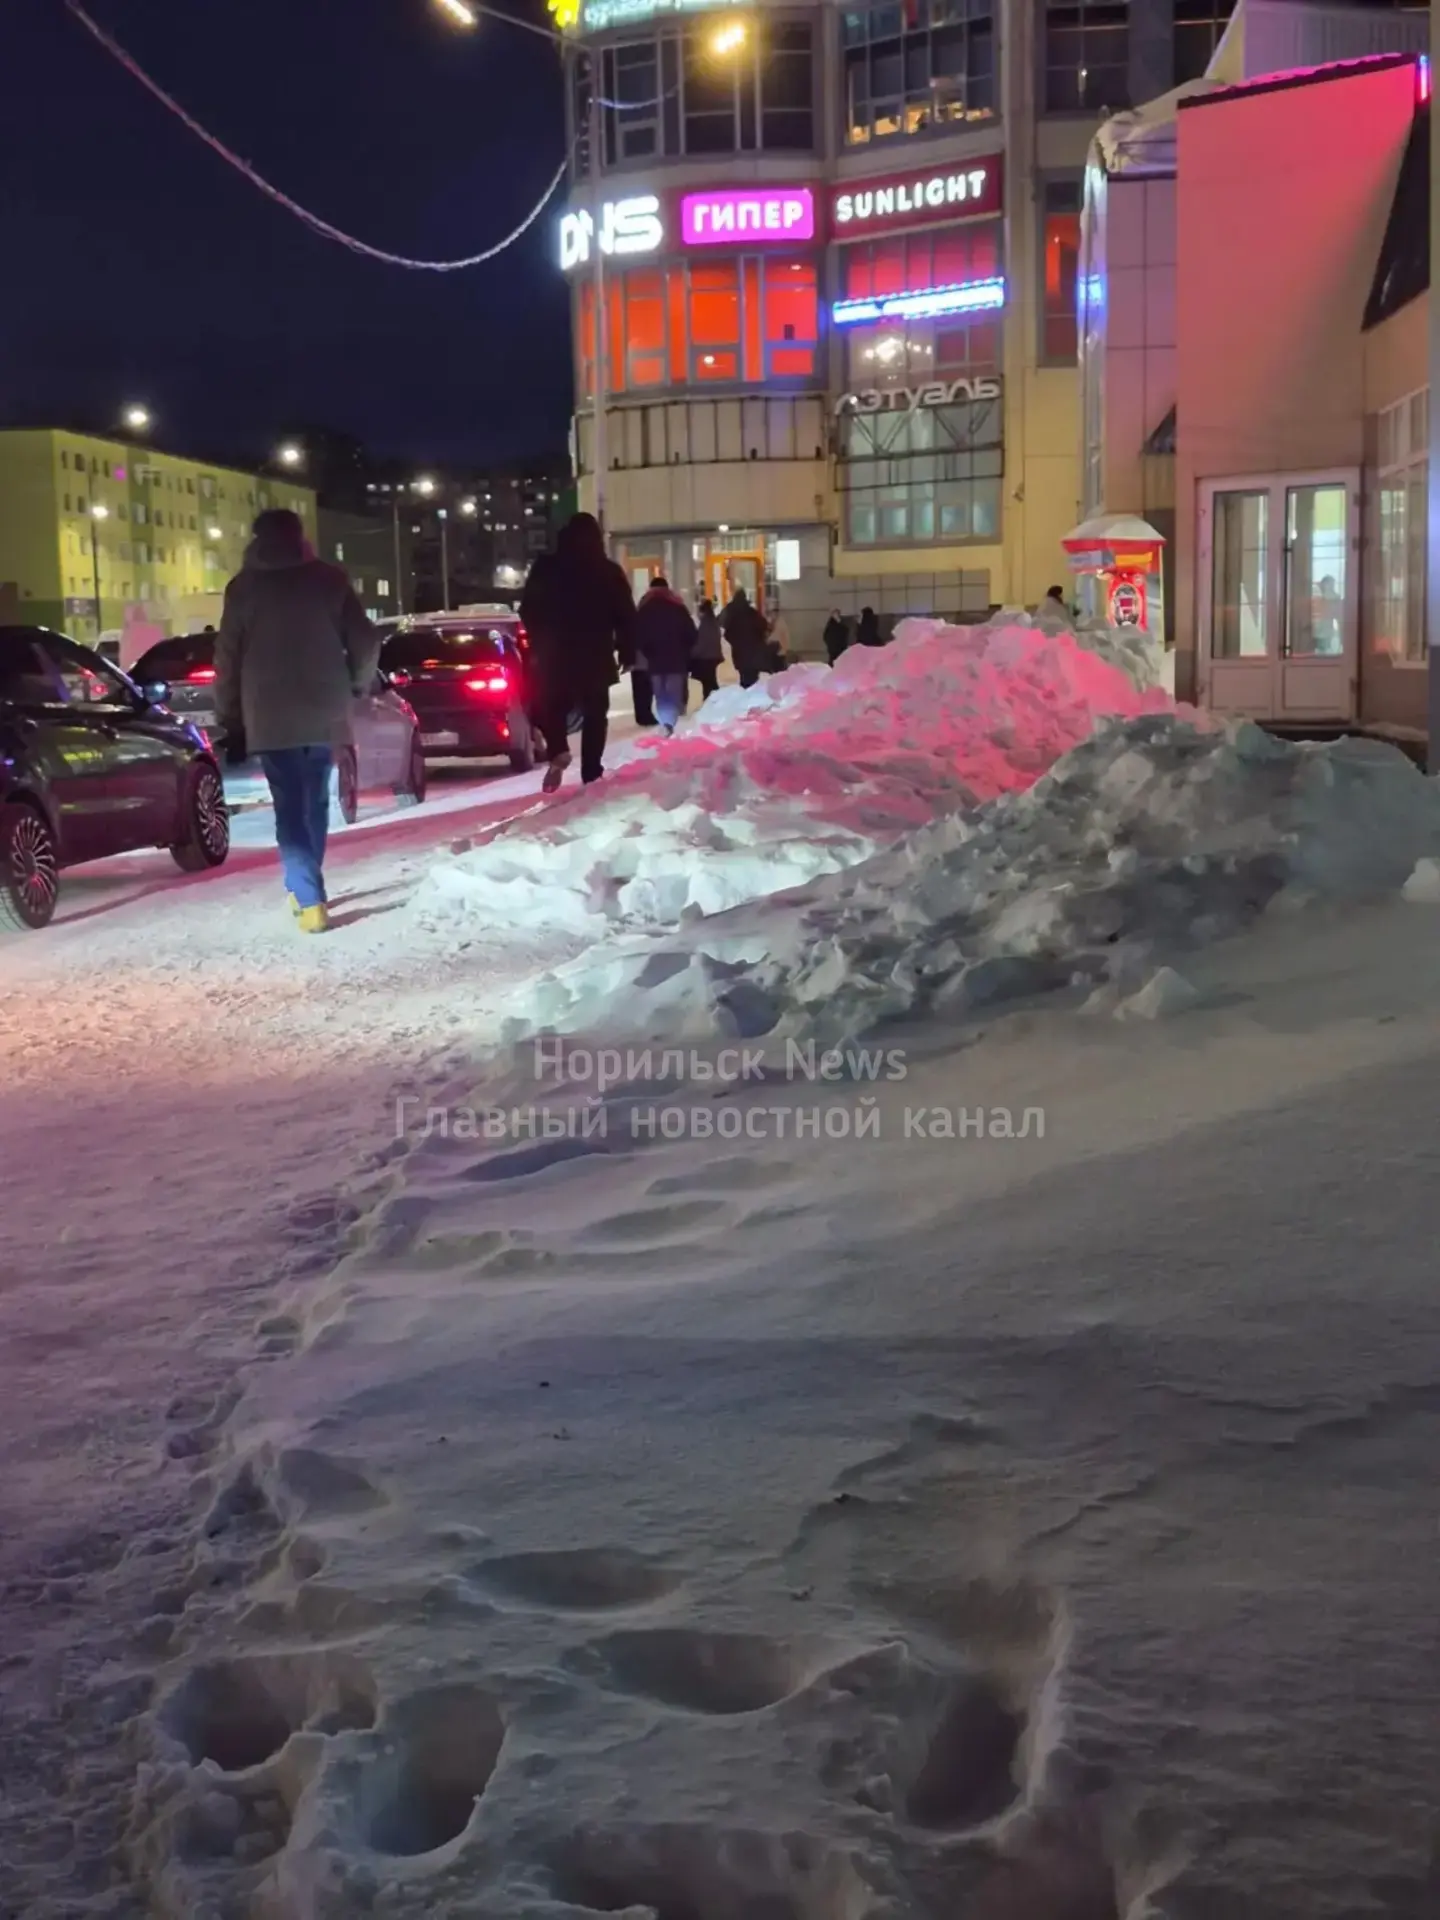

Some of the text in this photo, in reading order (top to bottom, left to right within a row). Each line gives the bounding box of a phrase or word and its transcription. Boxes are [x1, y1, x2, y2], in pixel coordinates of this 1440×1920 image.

[693, 200, 804, 232] ГИПЕР
[836, 169, 986, 222] SUNLIGHT
[560, 195, 663, 270] DNS
